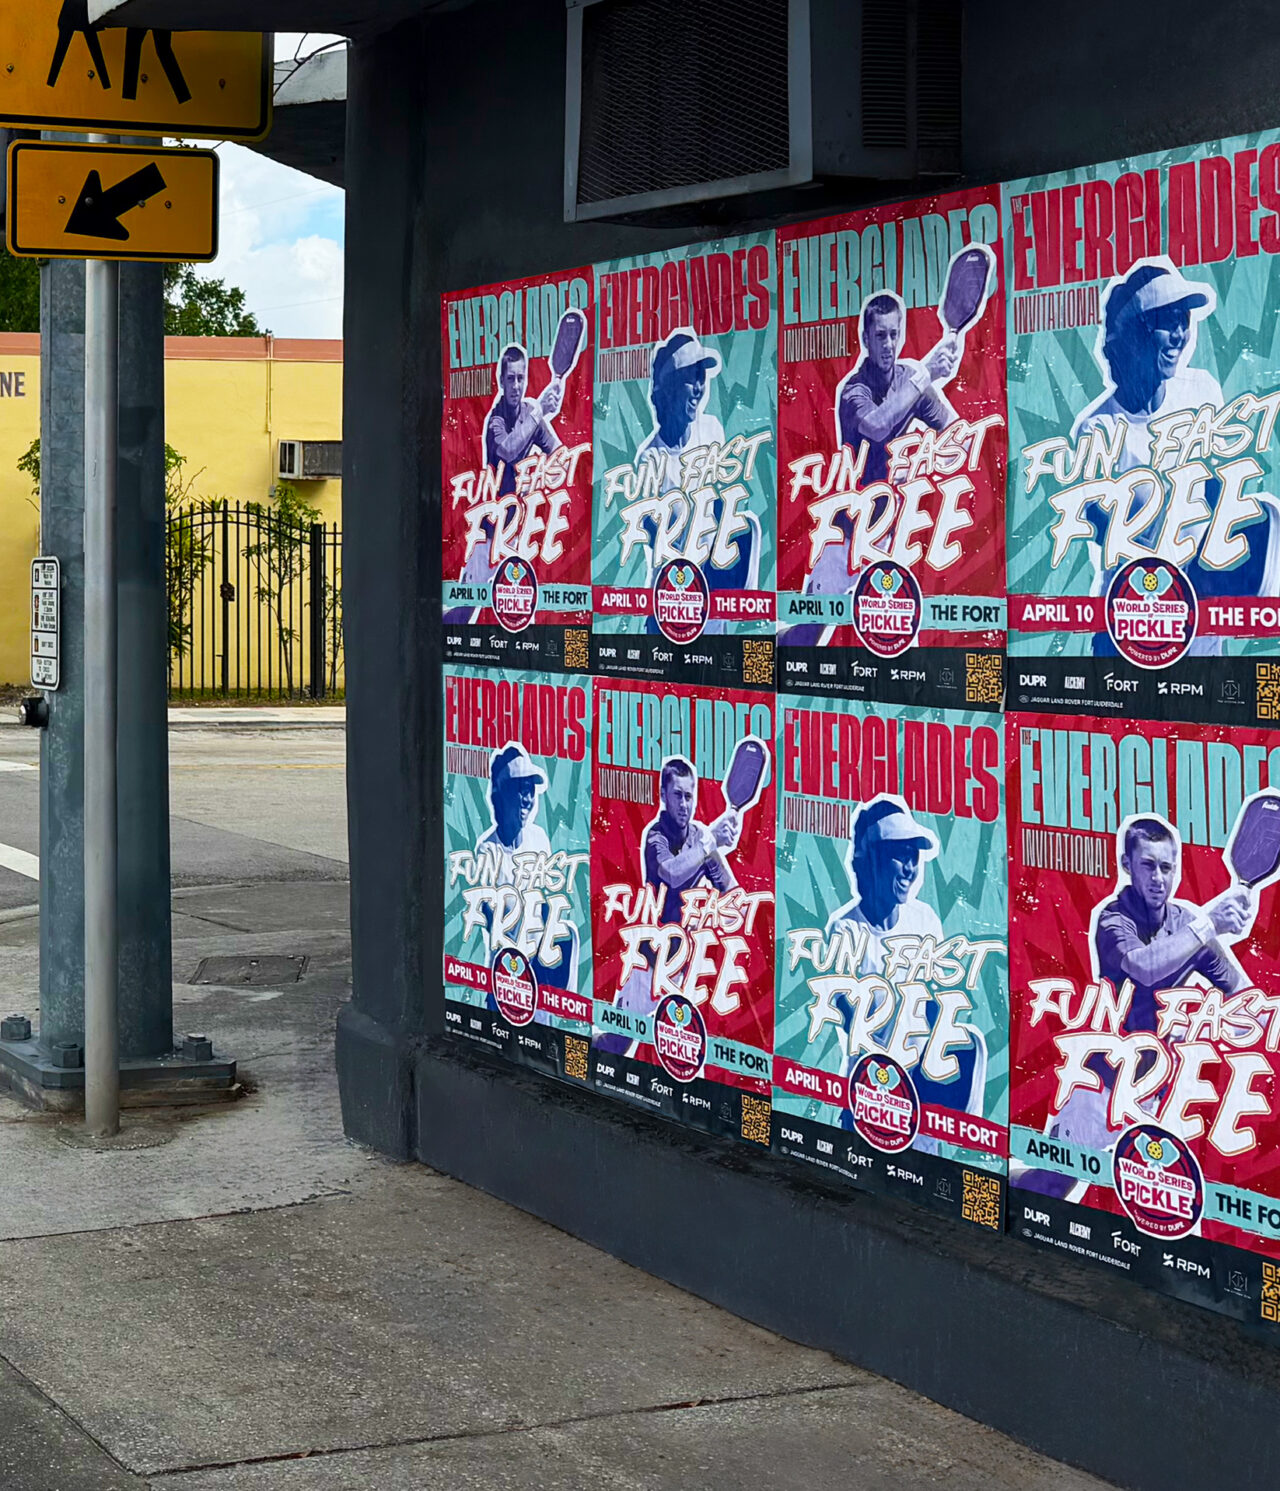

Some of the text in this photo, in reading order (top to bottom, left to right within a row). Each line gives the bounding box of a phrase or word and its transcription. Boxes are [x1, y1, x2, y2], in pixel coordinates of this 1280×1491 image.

[1011, 142, 1280, 293] EVERGLADES
[599, 244, 770, 350] EVERGLADES
[1013, 286, 1103, 335] INVITATIONAL
[783, 322, 852, 363] INVITATIONAL
[1022, 391, 1280, 494] FUN FAST
[604, 431, 773, 508] FUN FAST
[788, 414, 1005, 502] FUN FAST
[449, 442, 592, 511] FUN FAST
[808, 475, 976, 572] FREE
[1050, 456, 1266, 572] FREE
[464, 488, 572, 566] FREE
[620, 484, 750, 570] FREE
[449, 587, 488, 601] APRIL 10
[498, 598, 531, 612] PICKLE
[543, 590, 588, 606] THE FORT
[601, 592, 648, 609] APRIL 10
[659, 591, 703, 602] WORLD SERIES
[714, 597, 772, 614] THE FORT
[860, 598, 914, 610] WORLD SERIES
[659, 605, 701, 621] PICKLE
[789, 599, 845, 617] APRIL 10
[931, 604, 1001, 624] THE FORT
[1022, 603, 1095, 623] APRIL 10
[1115, 601, 1185, 614] WORLD SERIES
[1208, 606, 1244, 627] THE
[861, 614, 911, 632] PICKLE
[1117, 619, 1184, 639] PICKLE
[522, 642, 540, 651] RPM
[599, 647, 617, 659] DUPR
[652, 650, 674, 663] FORT
[1127, 645, 1178, 662] POWERED DUPR
[692, 654, 713, 665] RPM
[786, 660, 809, 674] DUPR
[853, 664, 878, 678] FORT
[900, 669, 926, 682] RPM
[1019, 674, 1047, 688] DUPR
[1106, 676, 1139, 693] FORT
[1030, 696, 1050, 704] JAGUAR
[1170, 683, 1204, 696] RPM
[445, 675, 586, 762] EVERGLADES
[1021, 728, 1032, 746] THE
[784, 708, 1000, 823] EVERGLADES
[784, 796, 852, 840] INVITATIONAL
[1021, 828, 1110, 879] INVITATIONAL
[449, 850, 590, 893] FUN FAST
[602, 880, 775, 936] FUN FAST
[462, 884, 571, 968] FREE
[620, 924, 751, 1016] FREE
[786, 928, 1008, 989] FUN FAST
[448, 962, 487, 985] APRIL 10
[542, 990, 588, 1017] THE FORT
[601, 1009, 647, 1035] APRIL 10
[1028, 977, 1280, 1054] FUN FAST
[659, 1023, 701, 1045] WORLD SERIES
[808, 975, 974, 1083] FREE
[659, 1037, 698, 1063] PICKLE
[714, 1043, 769, 1074] THE FORT
[596, 1063, 615, 1078] DUPR
[651, 1080, 674, 1097] FORT
[785, 1067, 843, 1099] APRIL 10
[1053, 1031, 1274, 1158] FREE
[689, 1095, 711, 1110] RPM
[857, 1085, 911, 1111] WORLD SERIES
[855, 1101, 911, 1133] PICKLE
[780, 1127, 804, 1145] DUPR
[925, 1111, 999, 1149] THE FORT
[1026, 1138, 1101, 1175] APRIL 10
[897, 1169, 924, 1187] RPM
[1120, 1160, 1193, 1192] WORLD SERIES
[1123, 1179, 1191, 1217] PICKLE
[1215, 1191, 1253, 1222] THE
[1023, 1206, 1051, 1228] DUPR
[1167, 1220, 1186, 1232] DUPR
[1033, 1232, 1054, 1244] JAGUAR
[1054, 1239, 1068, 1250] LAND
[1068, 1243, 1086, 1255] ROVER
[1086, 1249, 1099, 1260] FORT
[1113, 1234, 1141, 1257] FORT
[1176, 1257, 1211, 1279] RPM
